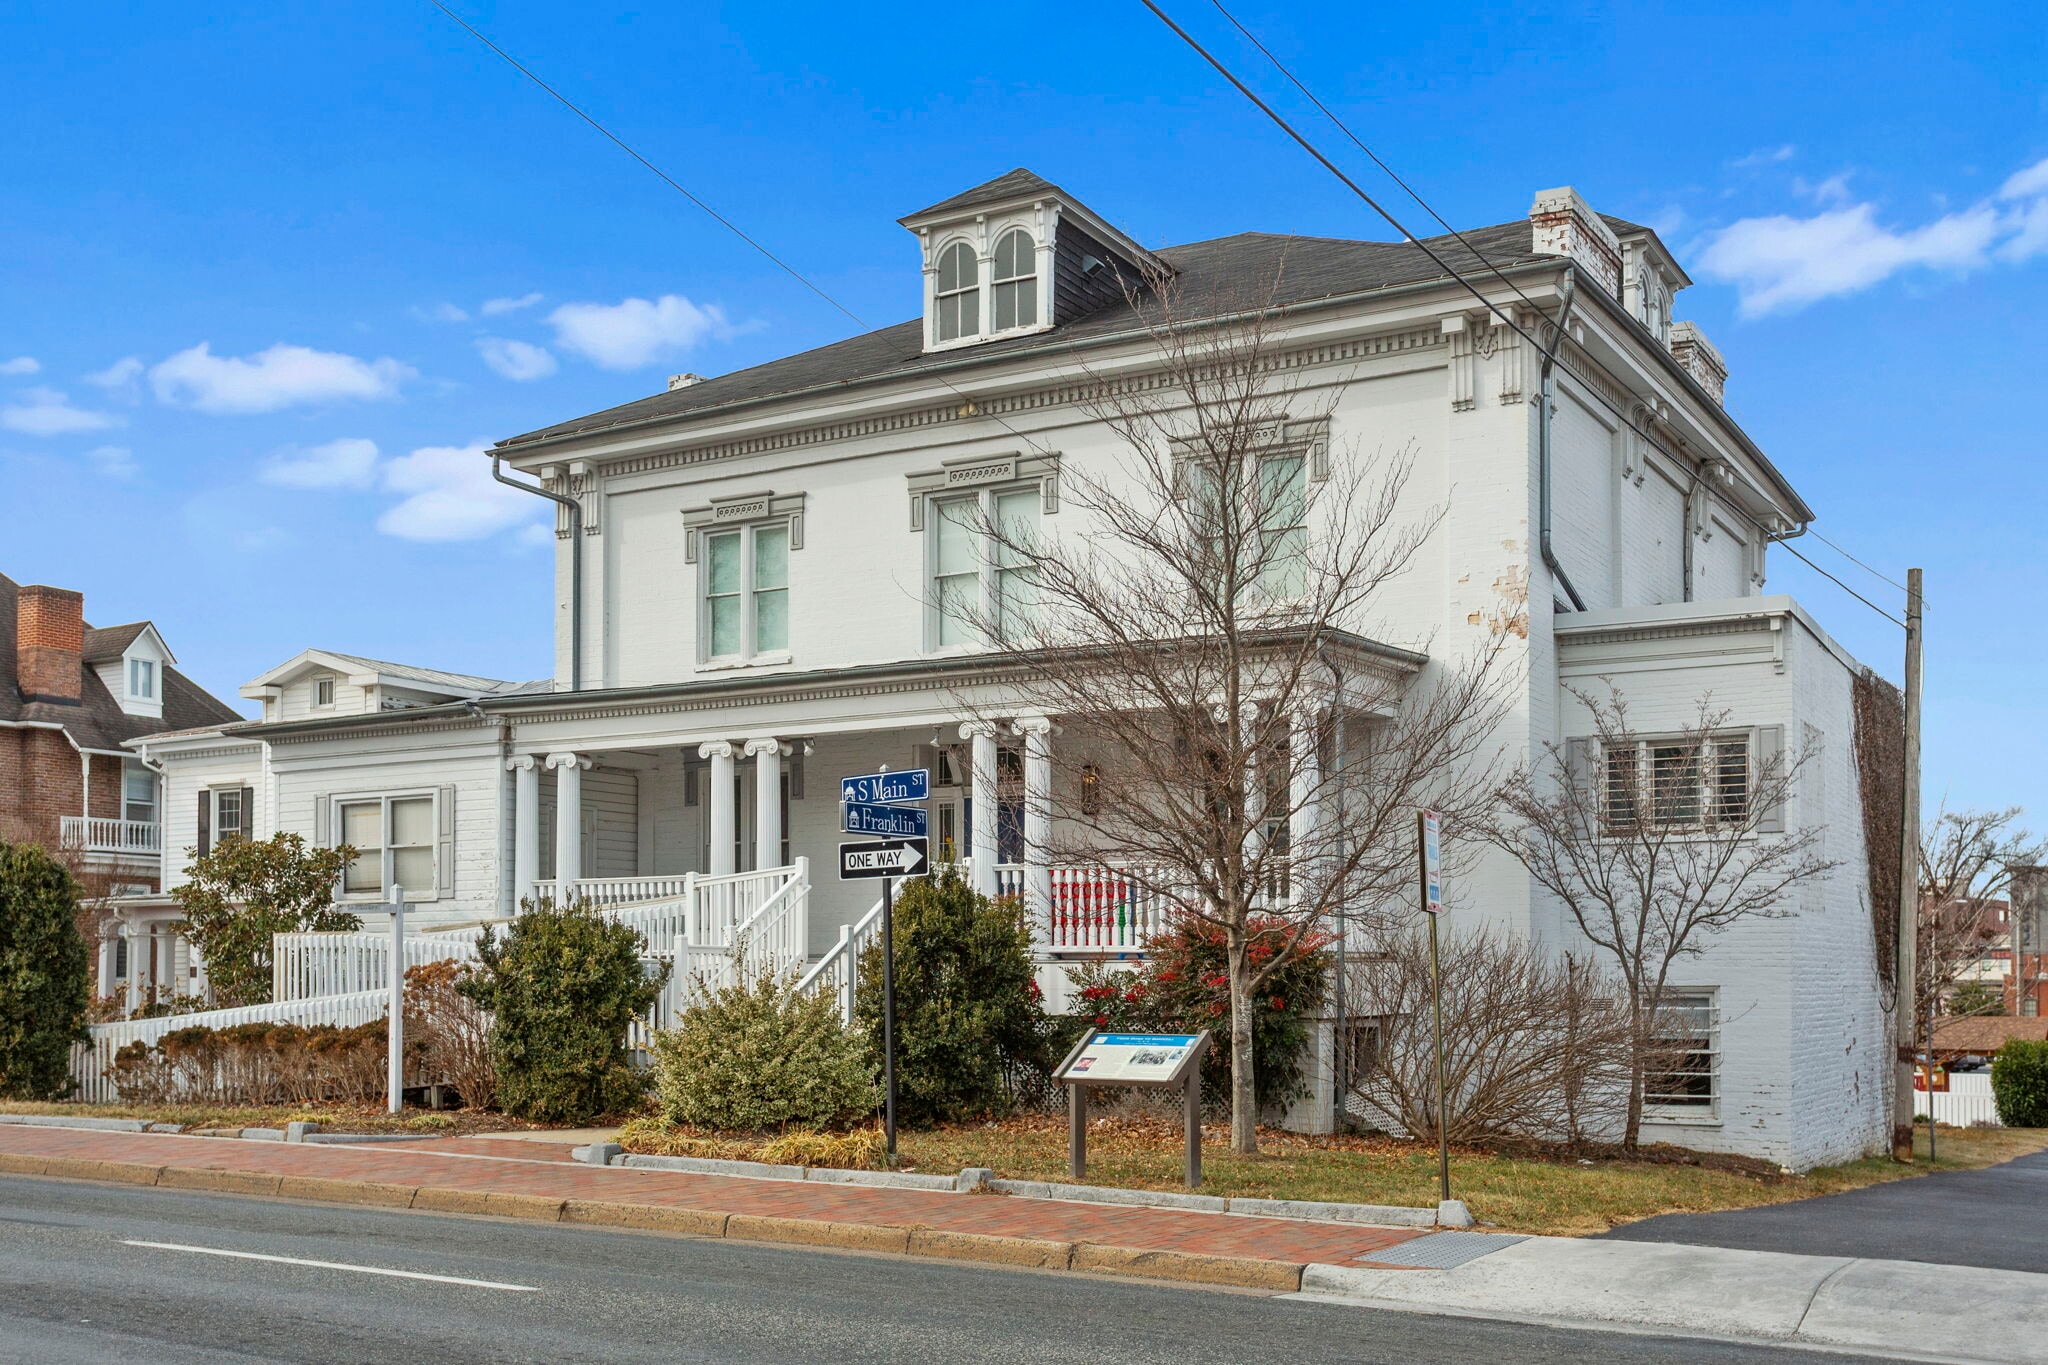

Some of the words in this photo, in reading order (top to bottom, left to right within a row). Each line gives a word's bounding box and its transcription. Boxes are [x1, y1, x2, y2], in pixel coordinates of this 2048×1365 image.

[858, 781, 868, 801] S
[872, 779, 908, 800] Main
[912, 774, 924, 785] ST
[862, 807, 915, 833] Franklin
[917, 812, 925, 824] ST
[848, 853, 872, 868] ONE
[877, 851, 901, 866] WAY
